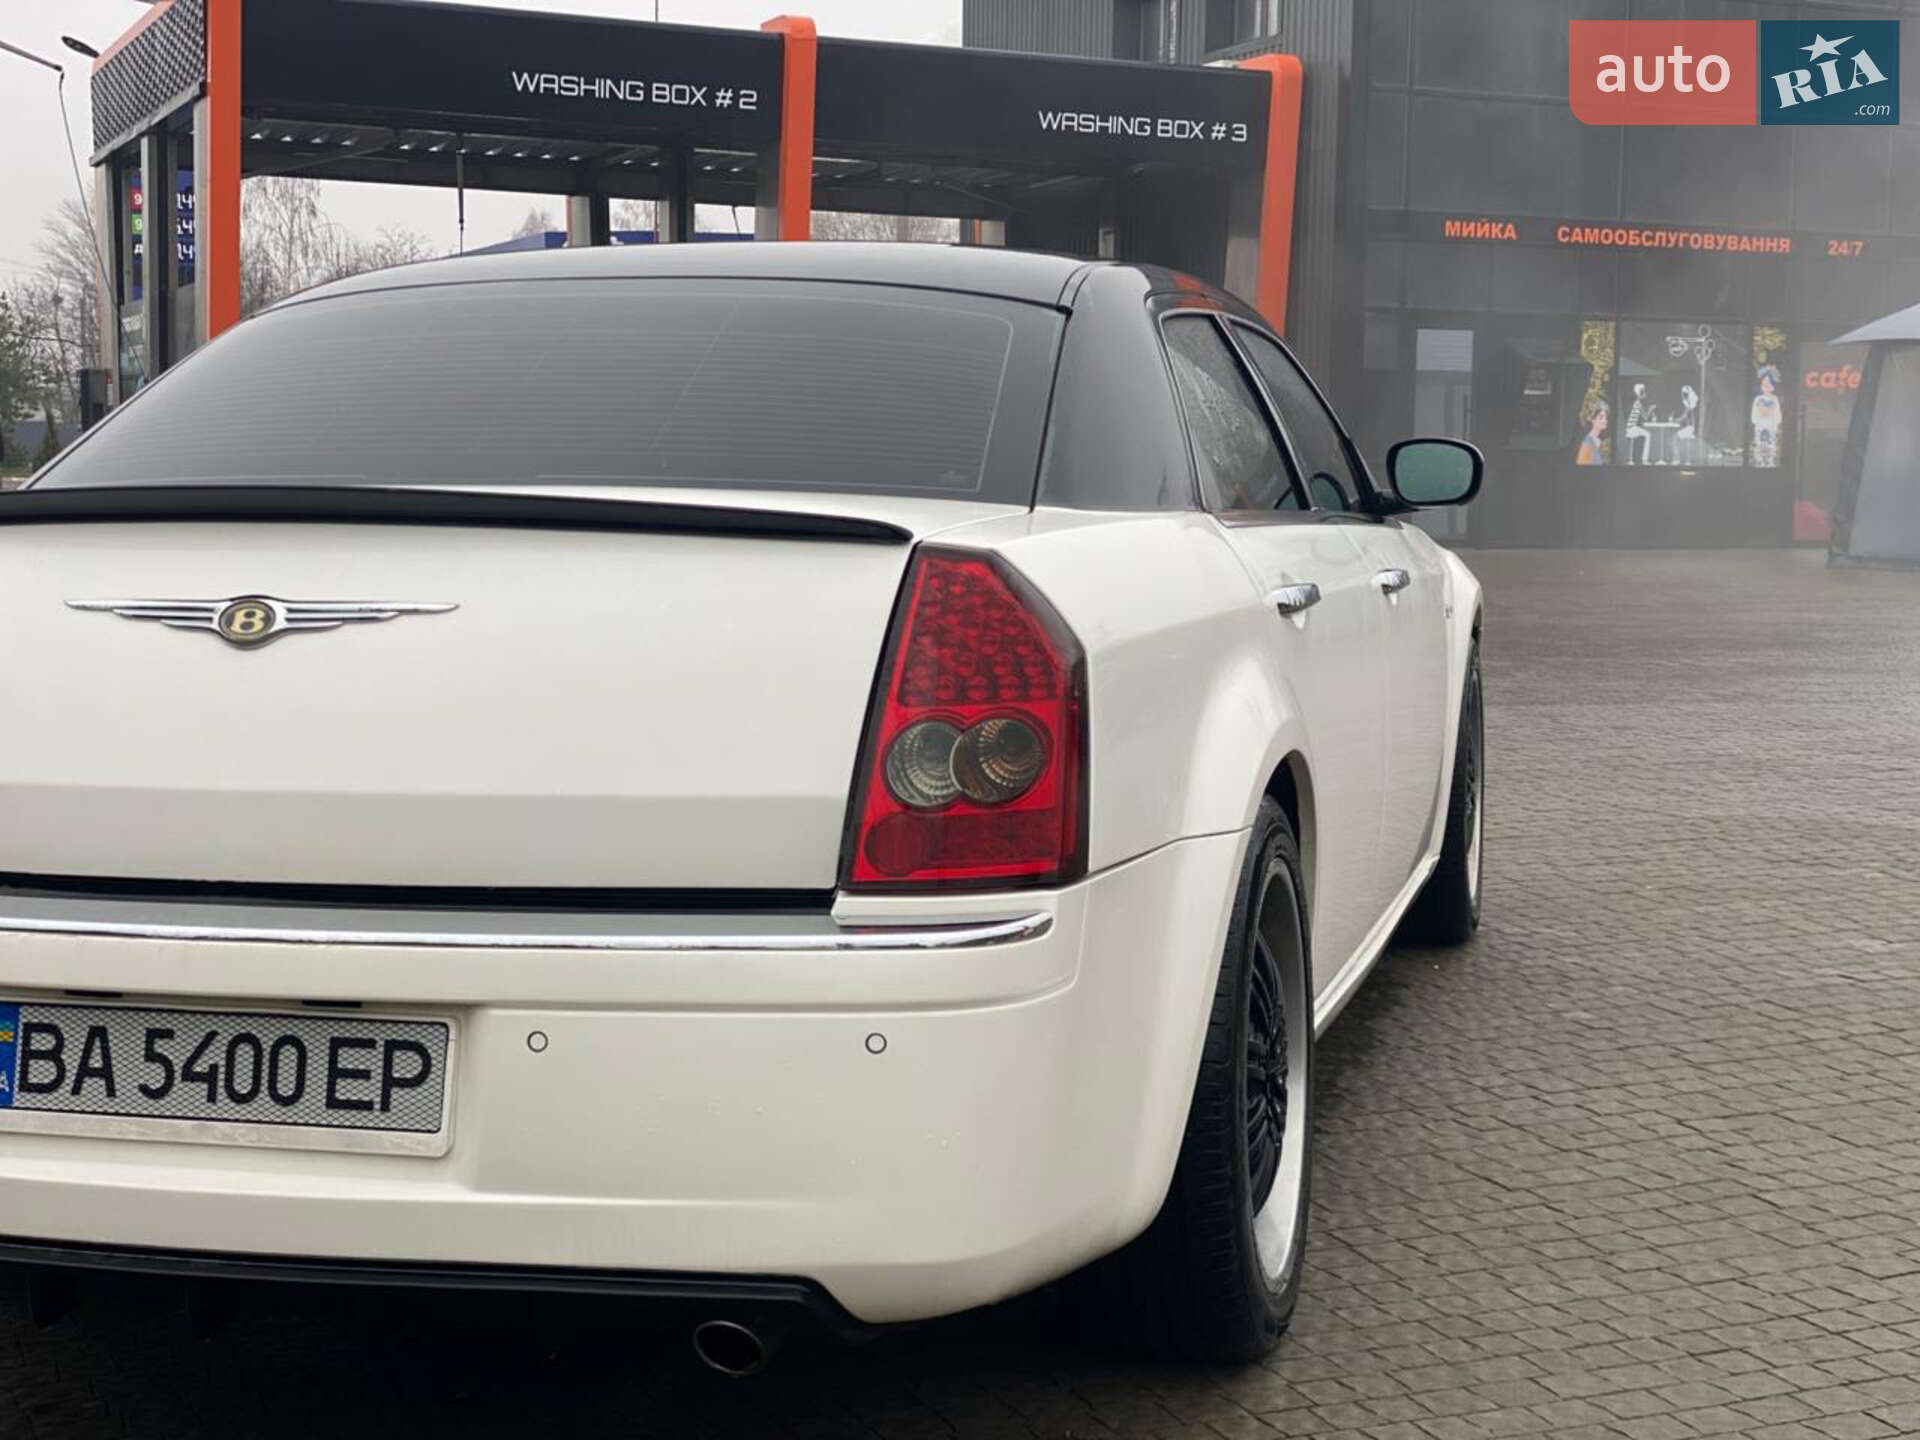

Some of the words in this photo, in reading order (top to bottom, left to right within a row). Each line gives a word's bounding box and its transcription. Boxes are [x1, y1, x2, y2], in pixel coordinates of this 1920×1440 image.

[512, 71, 644, 101] WASHING
[652, 82, 708, 107] BOX
[1038, 110, 1151, 136] WASHING
[1157, 118, 1205, 140] BOX
[1445, 218, 1518, 241] МИЙКА
[1557, 225, 1792, 254] САМООБСЛУГОВУВАННЯ
[230, 608, 265, 634] B
[18, 1021, 117, 1098] BA
[137, 1027, 308, 1107] 5400
[325, 1035, 433, 1113] EP
